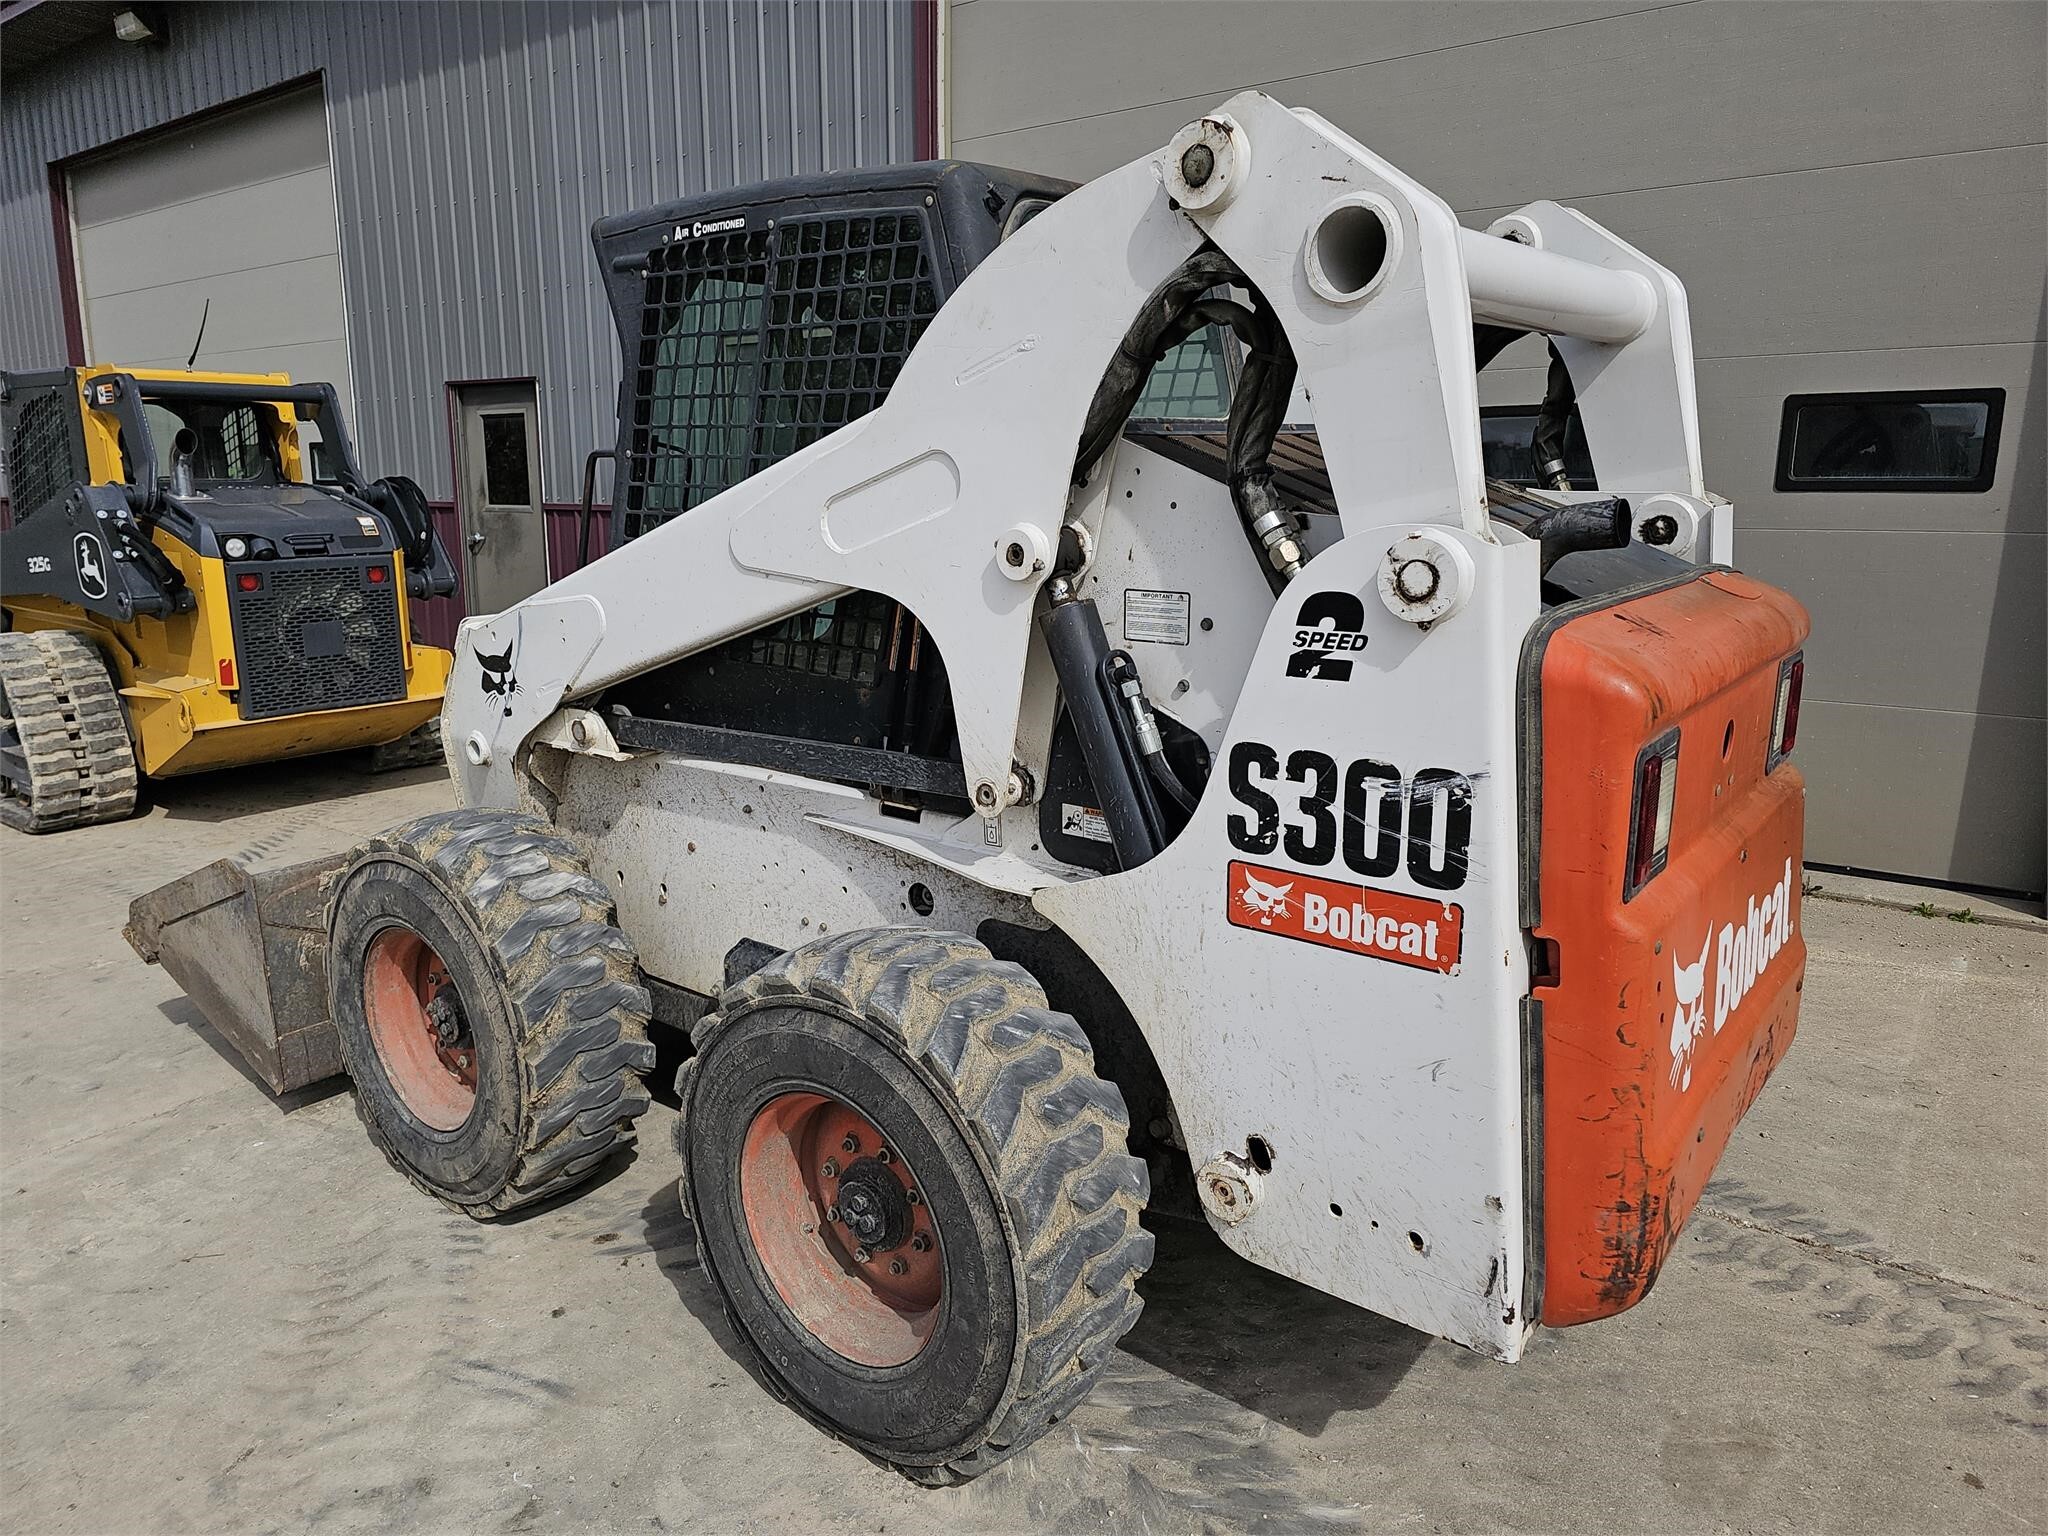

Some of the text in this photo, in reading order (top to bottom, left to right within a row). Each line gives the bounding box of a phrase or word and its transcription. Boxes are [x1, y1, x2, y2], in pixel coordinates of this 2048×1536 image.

[674, 218, 745, 241] AIR CONDITIONED
[27, 556, 52, 573] 325G
[1140, 592, 1174, 600] IMPORTANT
[1285, 591, 1369, 682] 2 SPEED
[1227, 741, 1473, 891] S300
[1303, 892, 1439, 961] Bobcat
[1713, 856, 1792, 1036] Bobcat
